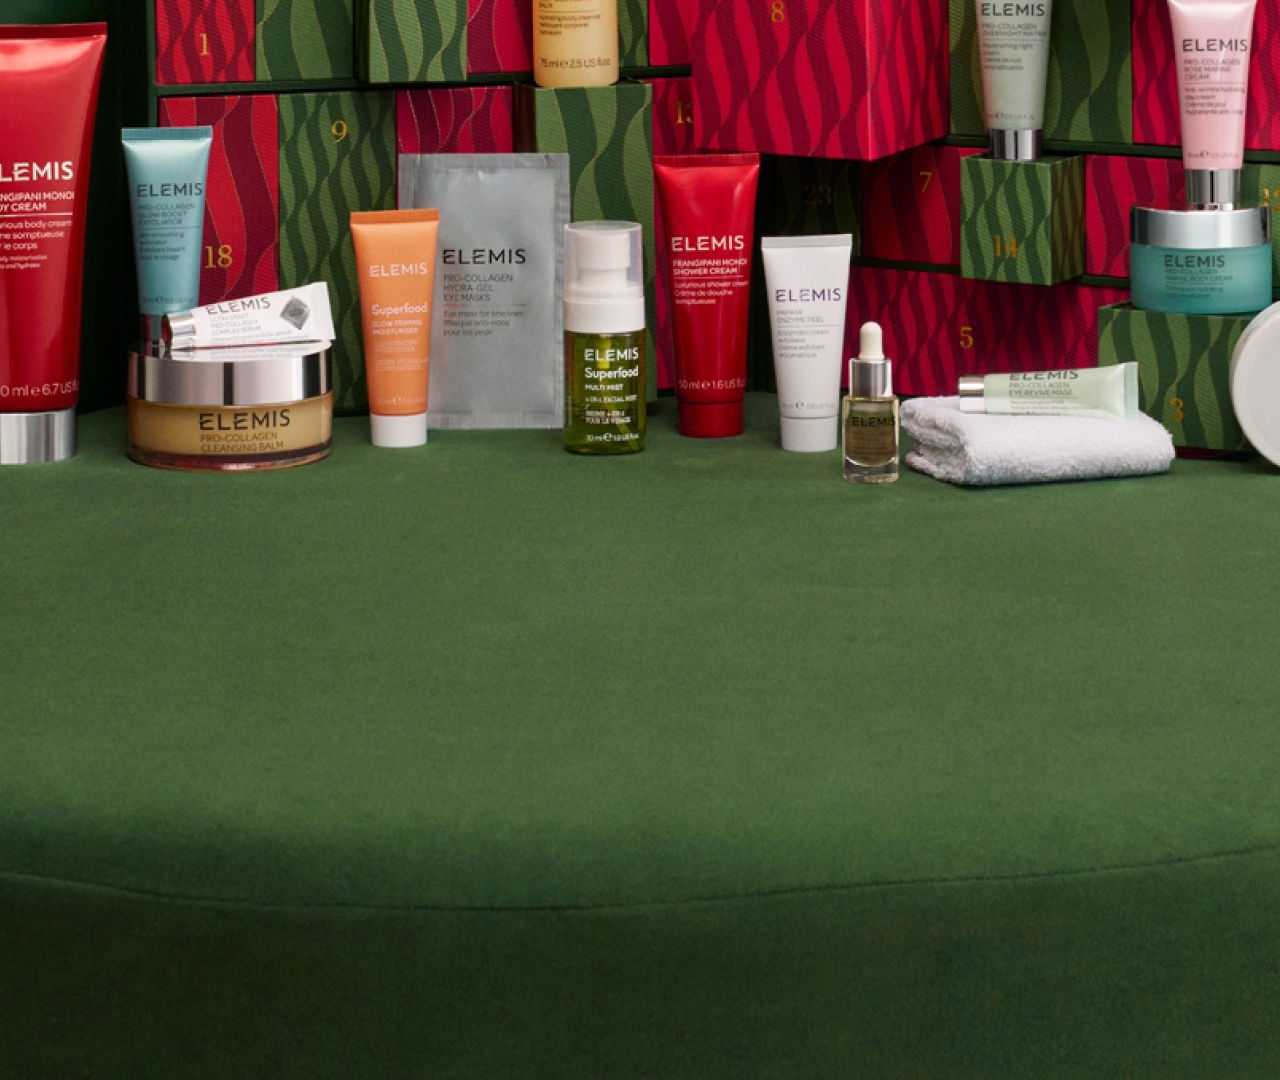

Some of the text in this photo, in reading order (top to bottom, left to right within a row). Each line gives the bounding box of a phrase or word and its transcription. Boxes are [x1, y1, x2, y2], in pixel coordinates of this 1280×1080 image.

[771, 0, 784, 24] 8
[981, 3, 1045, 16] ELEMIS
[199, 32, 209, 57] 1
[1183, 39, 1248, 52] ELEMIS
[332, 120, 347, 143] 9
[920, 172, 932, 192] 7
[136, 183, 203, 197] ELEMIS
[11, 202, 47, 212] CREAM
[24, 220, 47, 229] body
[12, 230, 64, 240] somptueuse
[4, 242, 12, 250] le
[12, 242, 38, 251] corps
[672, 235, 744, 251] ELEMIS
[205, 245, 233, 268] 18
[442, 248, 526, 264] ELEMIS
[1165, 254, 1225, 268] ELEMIS
[370, 263, 428, 278] ELEMIS
[444, 274, 513, 282] PRO-COLLAGEN
[444, 284, 493, 292] HYDRA-GEL
[776, 288, 841, 302] ELEMIS
[461, 293, 490, 301] MASKS
[206, 296, 271, 315] ELEMIS
[372, 303, 429, 317] Superfood
[959, 327, 973, 348] 5
[584, 347, 639, 361] ELEMIS
[584, 365, 639, 381] Superfood
[1009, 369, 1079, 380] ELEMIS
[12, 385, 28, 397] ml
[42, 383, 58, 396] 6.7
[1170, 396, 1184, 422] 3
[199, 409, 290, 431] ELEMIS
[852, 416, 895, 427] ELEMIS
[201, 432, 278, 442] PRO-COLLAGEN
[201, 441, 284, 452] CLEANSING BALM
